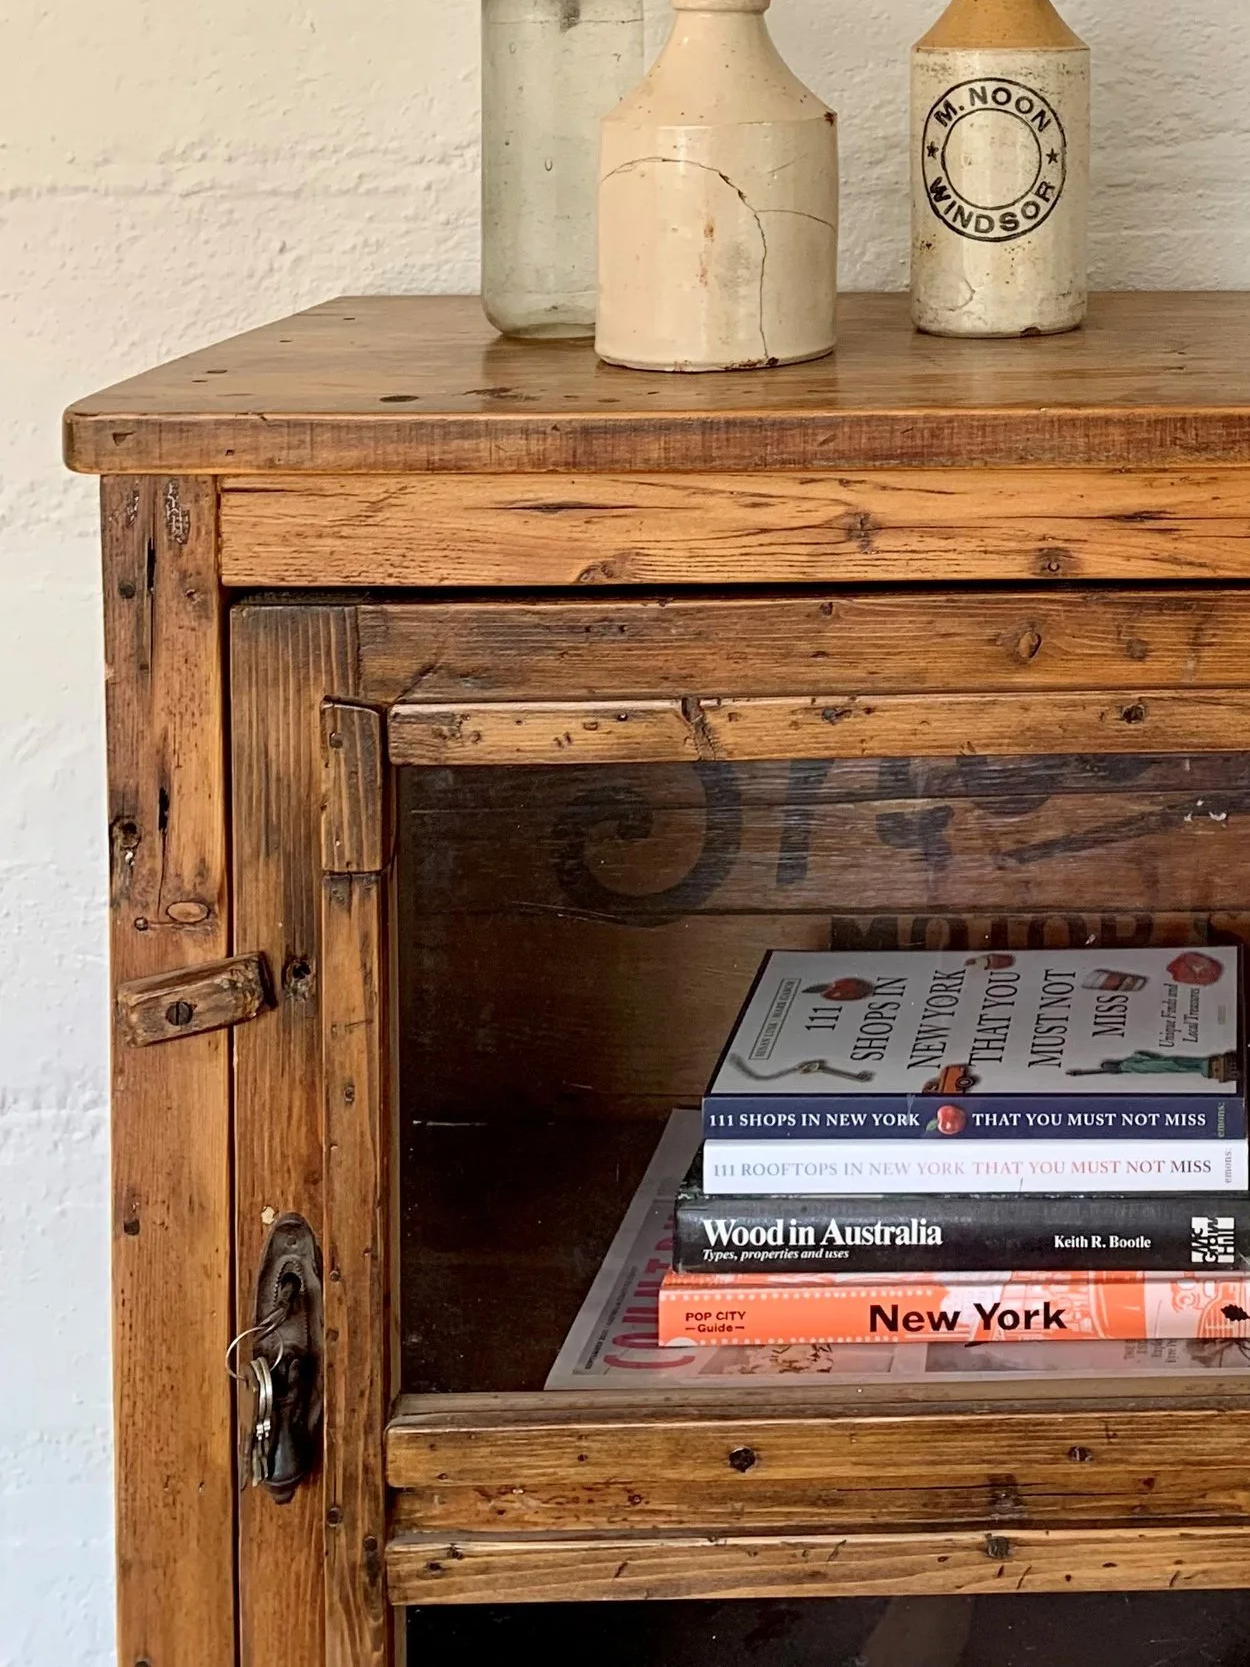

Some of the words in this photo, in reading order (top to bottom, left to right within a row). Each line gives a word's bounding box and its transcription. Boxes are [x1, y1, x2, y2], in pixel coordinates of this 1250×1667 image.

[968, 86, 1052, 132] NOON
[929, 176, 1056, 234] WINDSOR
[871, 976, 909, 997] IN
[921, 969, 966, 1020] YORK
[982, 971, 1020, 1010] YOU
[1039, 969, 1076, 1009] NOT
[1163, 983, 1178, 997] and
[805, 1005, 843, 1031] 111
[850, 1001, 901, 1061] SHOPS
[1091, 995, 1129, 1038] MISS
[907, 1023, 952, 1070] NEW
[967, 1014, 1012, 1067] THAT
[1028, 1013, 1069, 1068] MUST
[1158, 1020, 1182, 1047] Unique
[1182, 1022, 1199, 1043] Local
[709, 1113, 734, 1127] 111
[739, 1113, 796, 1127] SHOPS
[801, 1113, 821, 1127] IN
[826, 1113, 867, 1127] NEW
[872, 1113, 920, 1127] YORK
[972, 1113, 1021, 1126] THAT
[1025, 1113, 1062, 1126] YOU
[1067, 1113, 1116, 1126] MUST
[1121, 1113, 1160, 1126] NOT
[1165, 1113, 1206, 1126] MISS
[713, 1164, 735, 1177] 111
[741, 1163, 838, 1177] ROOFTOPS
[844, 1162, 863, 1176] IN
[869, 1162, 911, 1176] NEW
[916, 1161, 966, 1176] YORK
[972, 1161, 1023, 1175] THAT
[1028, 1161, 1065, 1175] YOU
[1071, 1161, 1121, 1174] MUST
[1126, 1160, 1166, 1174] NOT
[1170, 1160, 1212, 1174] MISS
[702, 1218, 785, 1246] Wood
[788, 1218, 816, 1246] in
[819, 1217, 943, 1246] Australia
[1054, 1235, 1089, 1249] Keith
[1091, 1235, 1107, 1249] R.
[1109, 1235, 1152, 1249] Bootle
[702, 1249, 738, 1262] Types,
[740, 1248, 799, 1262] properties
[800, 1248, 823, 1259] and
[825, 1250, 850, 1259] uses
[685, 1311, 712, 1322] POP
[716, 1311, 746, 1321] CITY
[869, 1304, 960, 1332] New
[974, 1302, 1068, 1331] York
